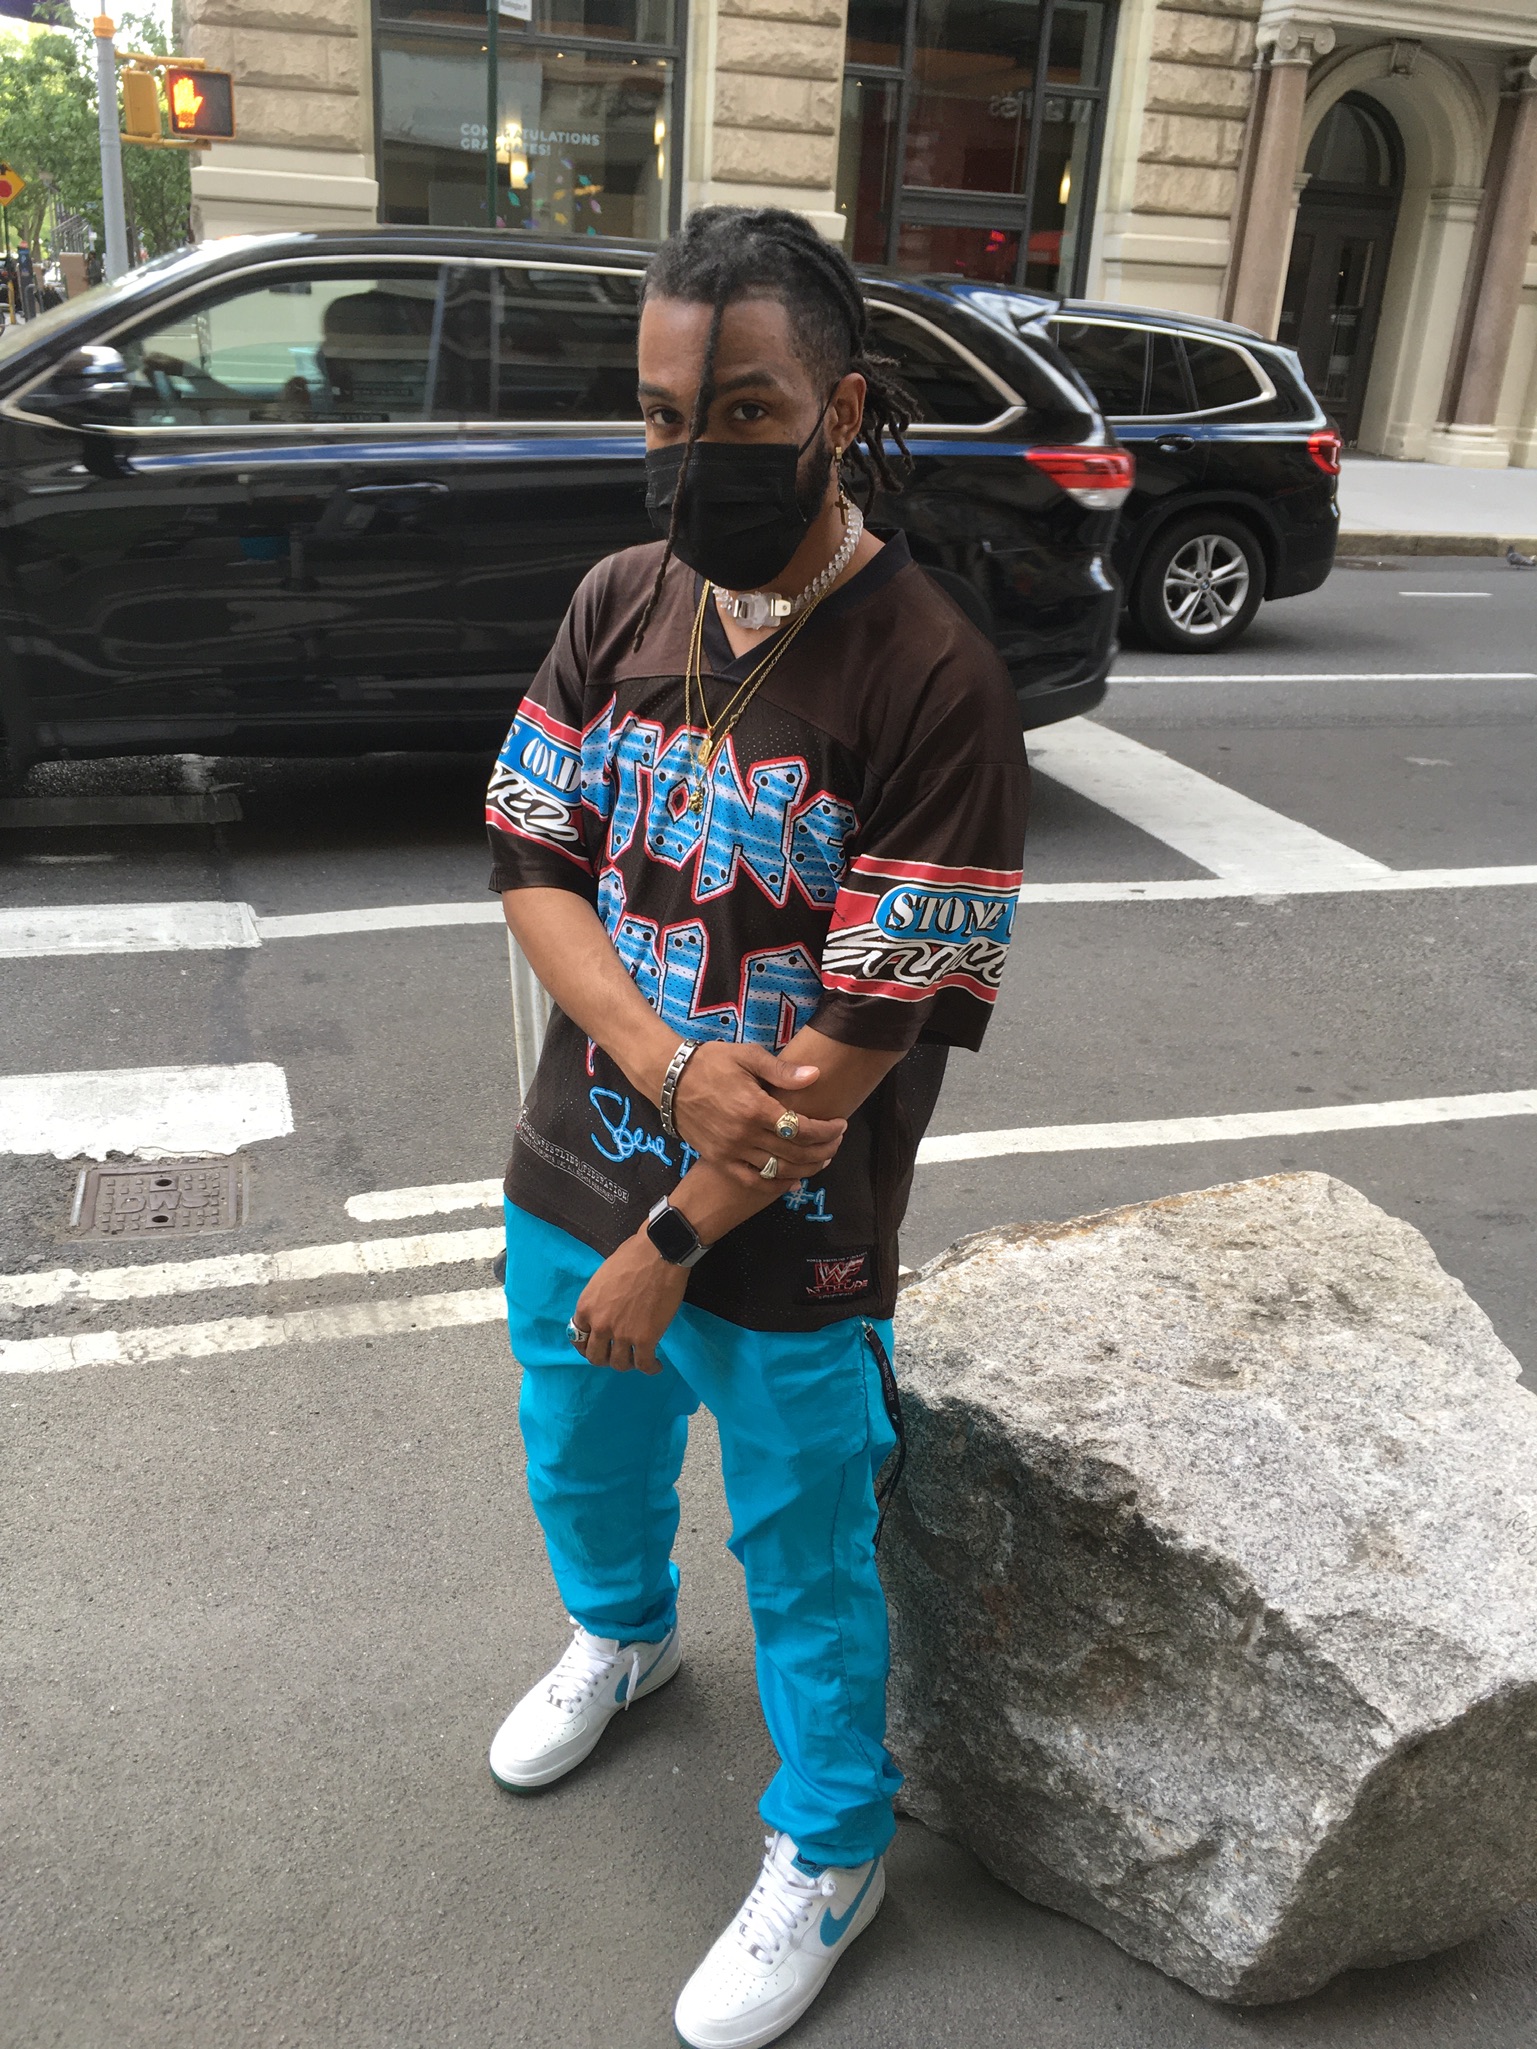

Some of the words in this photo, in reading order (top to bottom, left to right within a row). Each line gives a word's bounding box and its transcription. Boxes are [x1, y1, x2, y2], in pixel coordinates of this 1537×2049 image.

[460, 123, 600, 146] CONRATULATIONS
[520, 738, 583, 793] COLD
[580, 689, 861, 912] STONE
[886, 892, 1010, 937] STONE
[782, 1178, 833, 1222] #1
